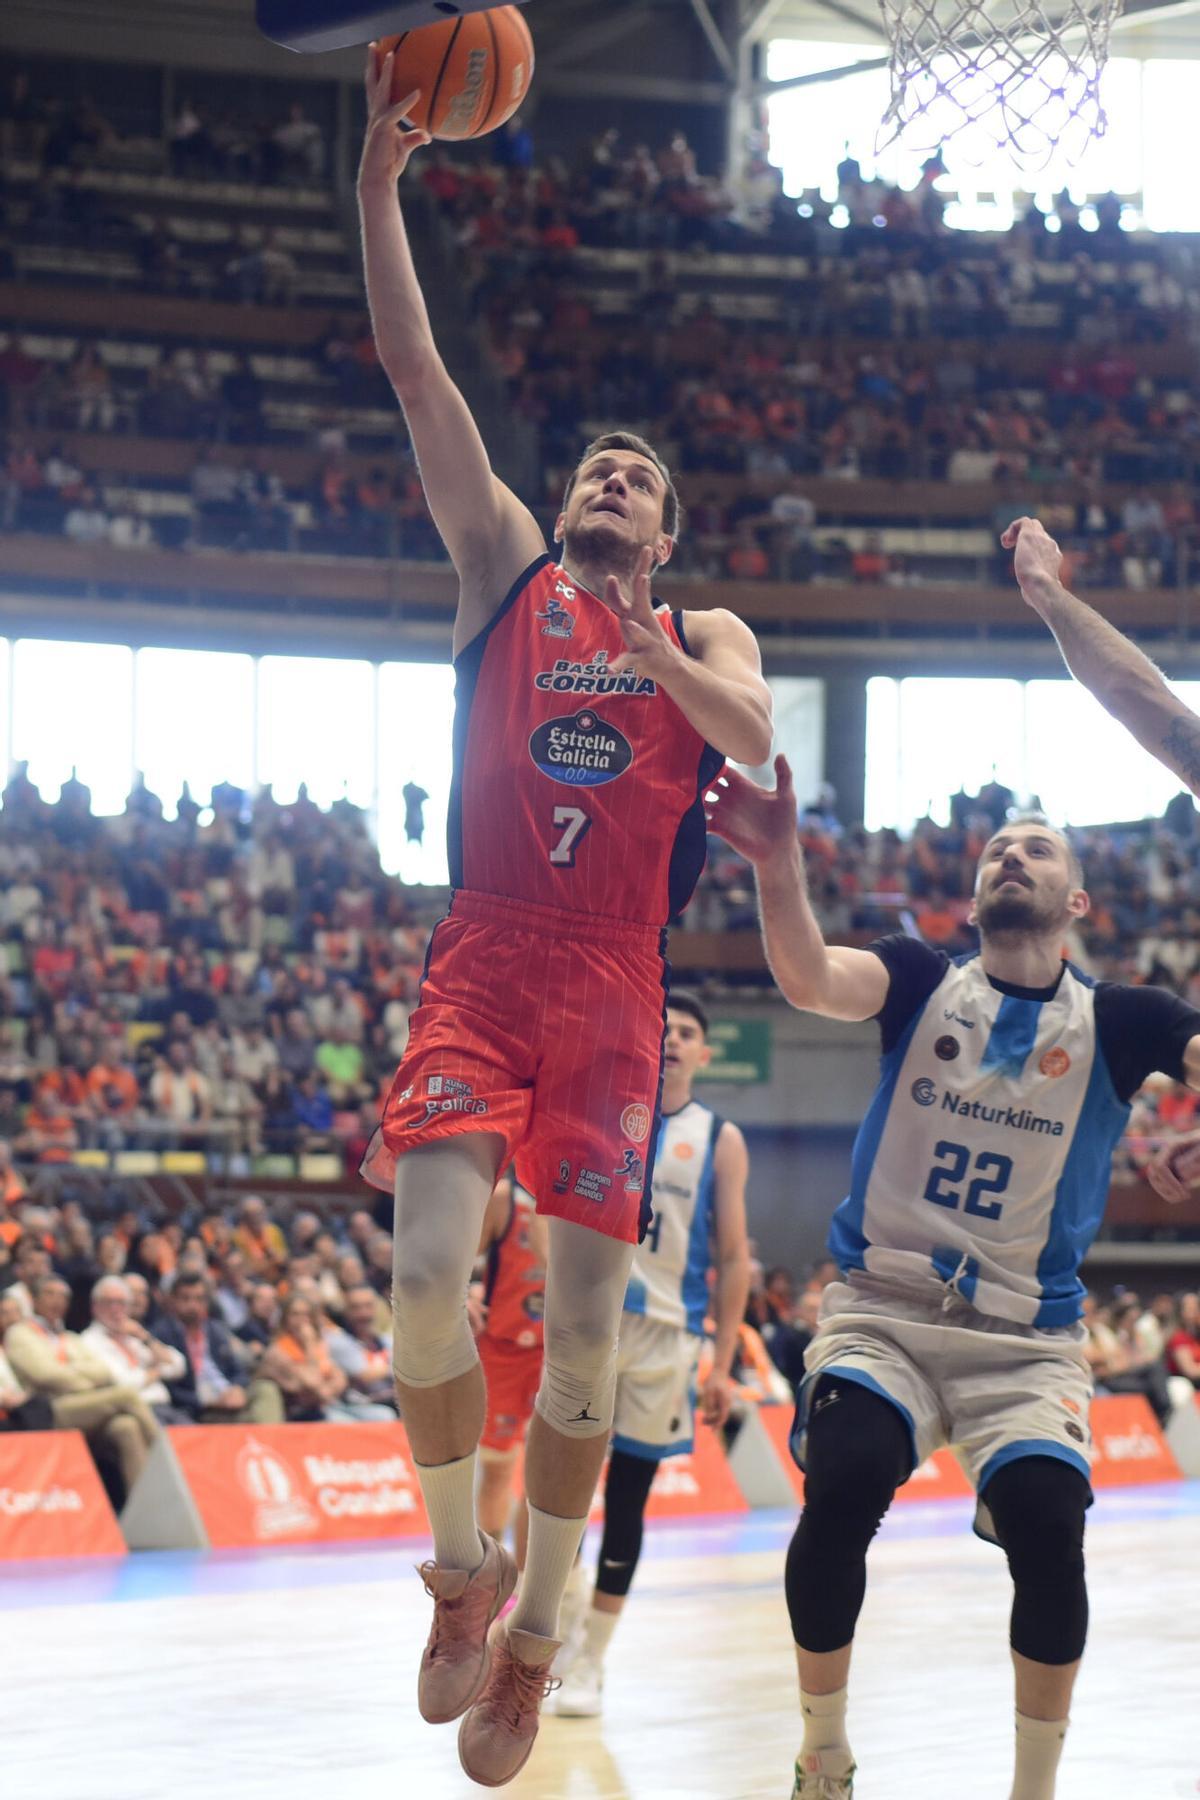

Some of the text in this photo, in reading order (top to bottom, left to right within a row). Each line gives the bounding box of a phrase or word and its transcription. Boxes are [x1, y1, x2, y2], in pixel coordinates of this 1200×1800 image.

[547, 726, 617, 752] Estrella
[547, 744, 611, 769] Galicia
[550, 805, 592, 867] 7
[941, 1090, 1065, 1137] Naturklima
[923, 1139, 1014, 1221] 22
